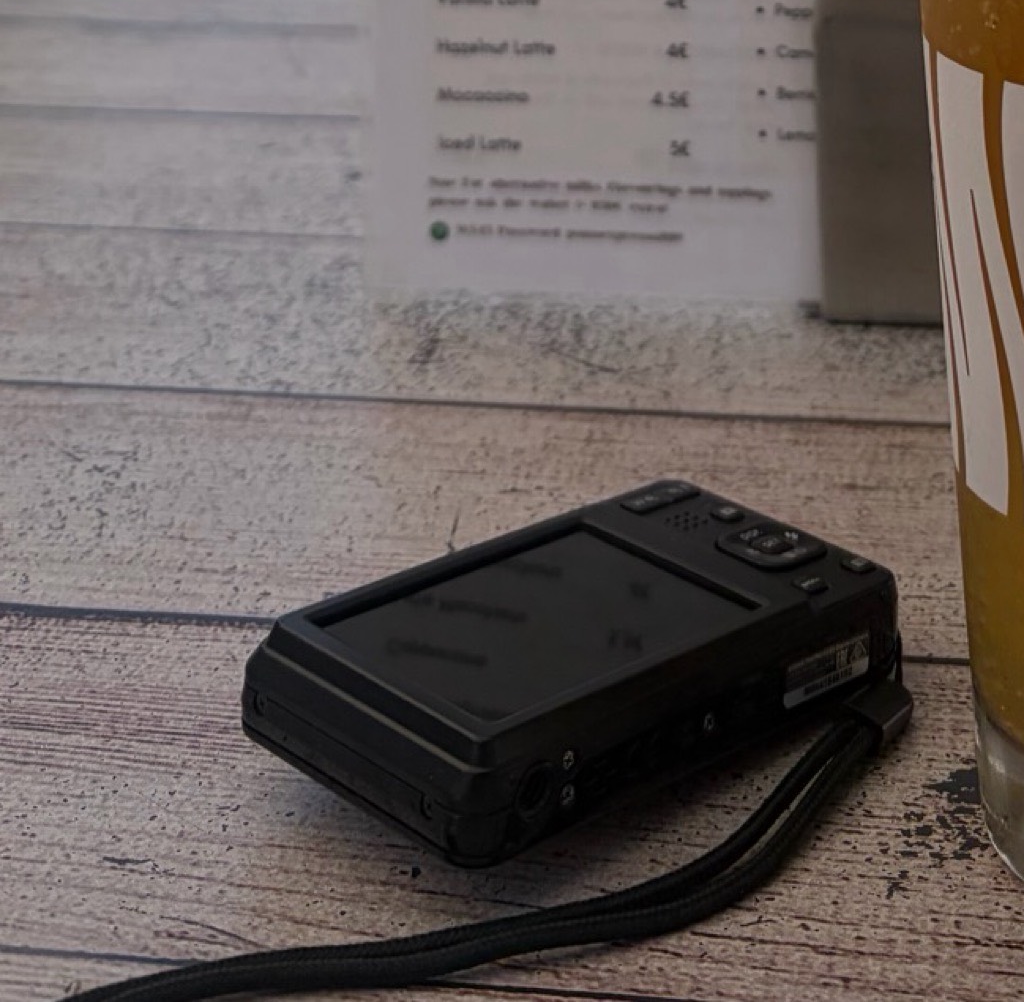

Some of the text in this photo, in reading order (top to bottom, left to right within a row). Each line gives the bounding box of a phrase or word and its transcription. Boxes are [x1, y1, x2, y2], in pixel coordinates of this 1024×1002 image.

[436, 39, 556, 55] Hazelnut Latte
[666, 43, 689, 59] 4€
[438, 134, 522, 150] Iced Latte
